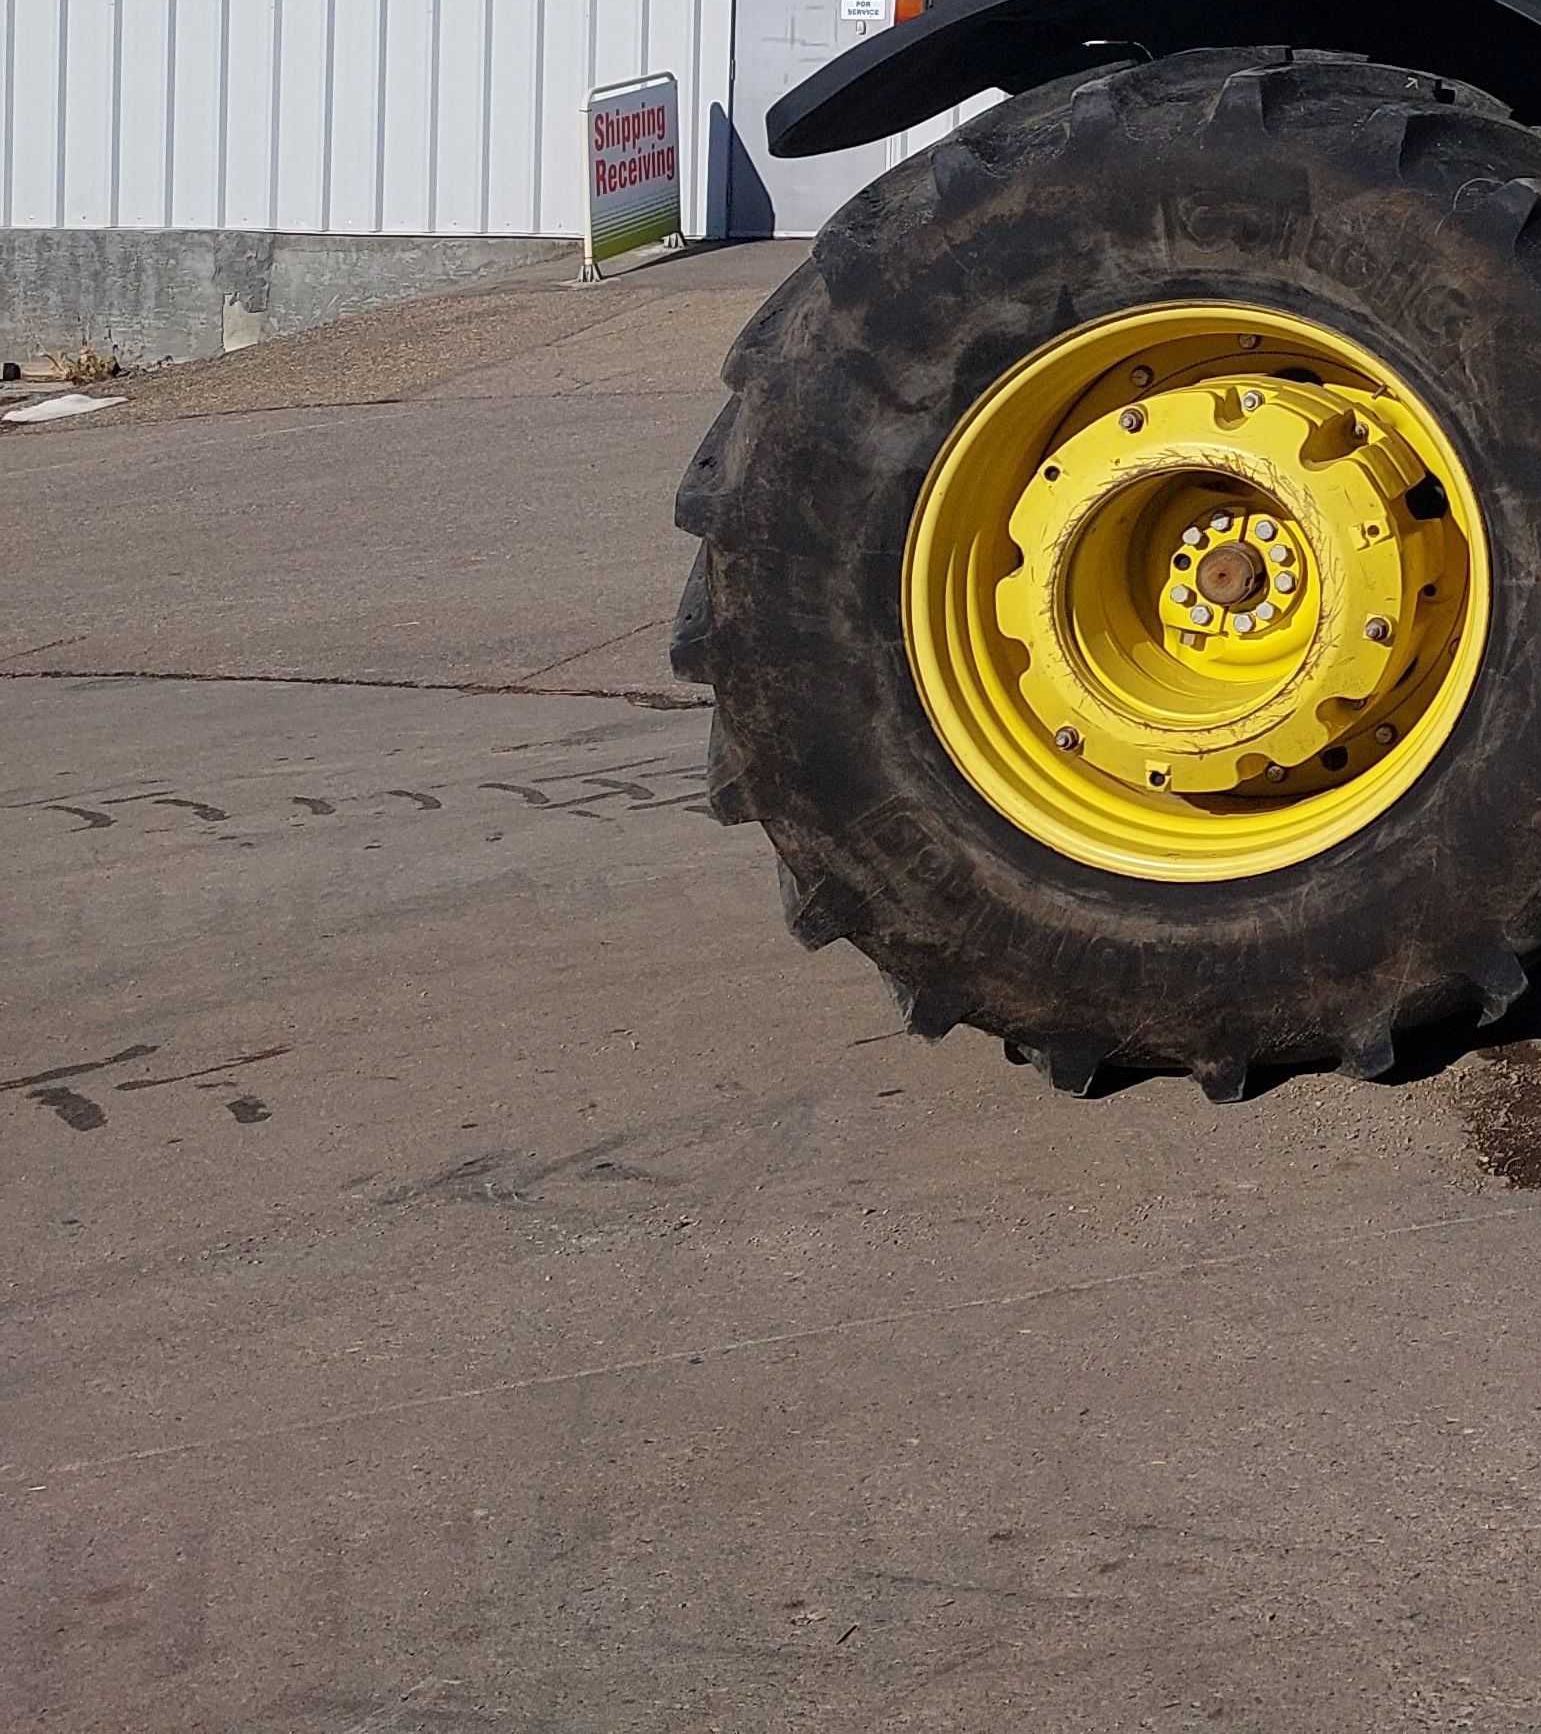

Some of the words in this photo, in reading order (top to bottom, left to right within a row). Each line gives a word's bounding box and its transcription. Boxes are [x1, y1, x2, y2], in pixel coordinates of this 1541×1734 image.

[847, 8, 880, 16] SERVICE
[855, 0, 872, 8] FOR
[594, 101, 666, 153] Shipping
[595, 143, 675, 198] Receiving
